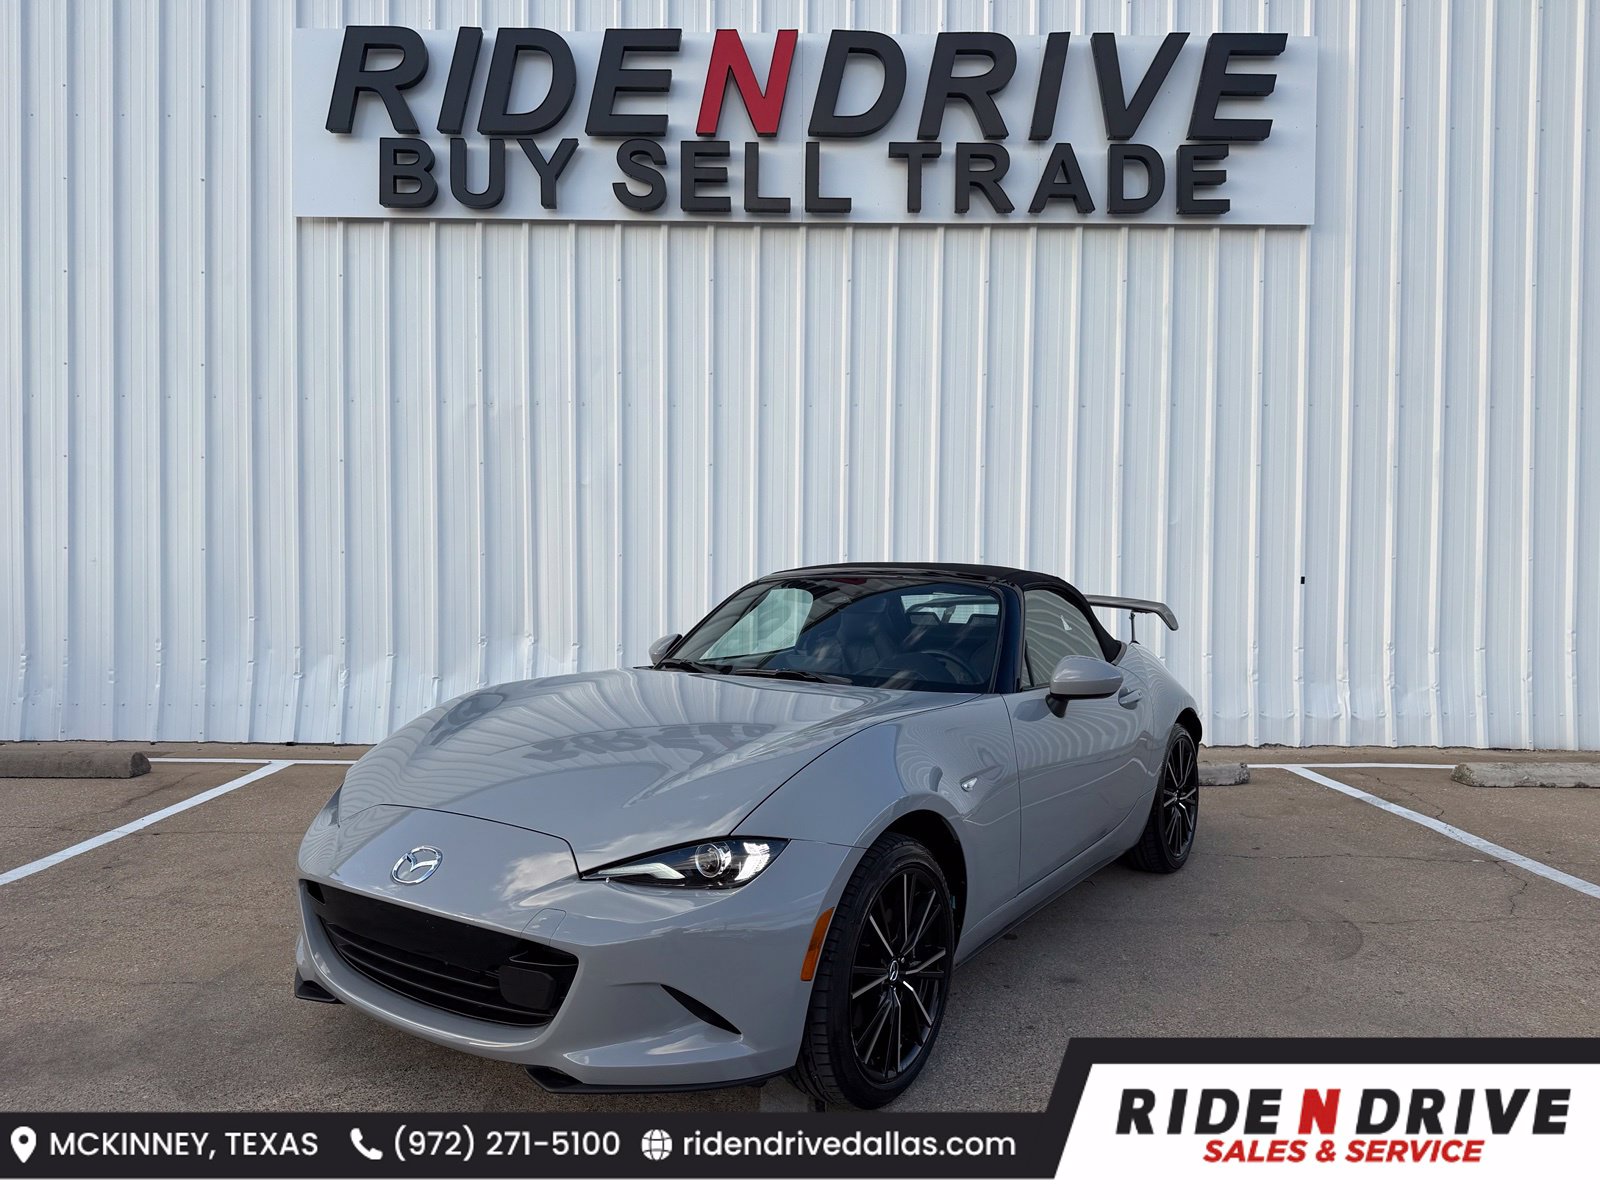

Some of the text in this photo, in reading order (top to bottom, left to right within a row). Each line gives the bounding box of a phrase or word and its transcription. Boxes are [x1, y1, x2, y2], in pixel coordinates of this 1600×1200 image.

[379, 137, 1231, 215] BUY SELL TRADE
